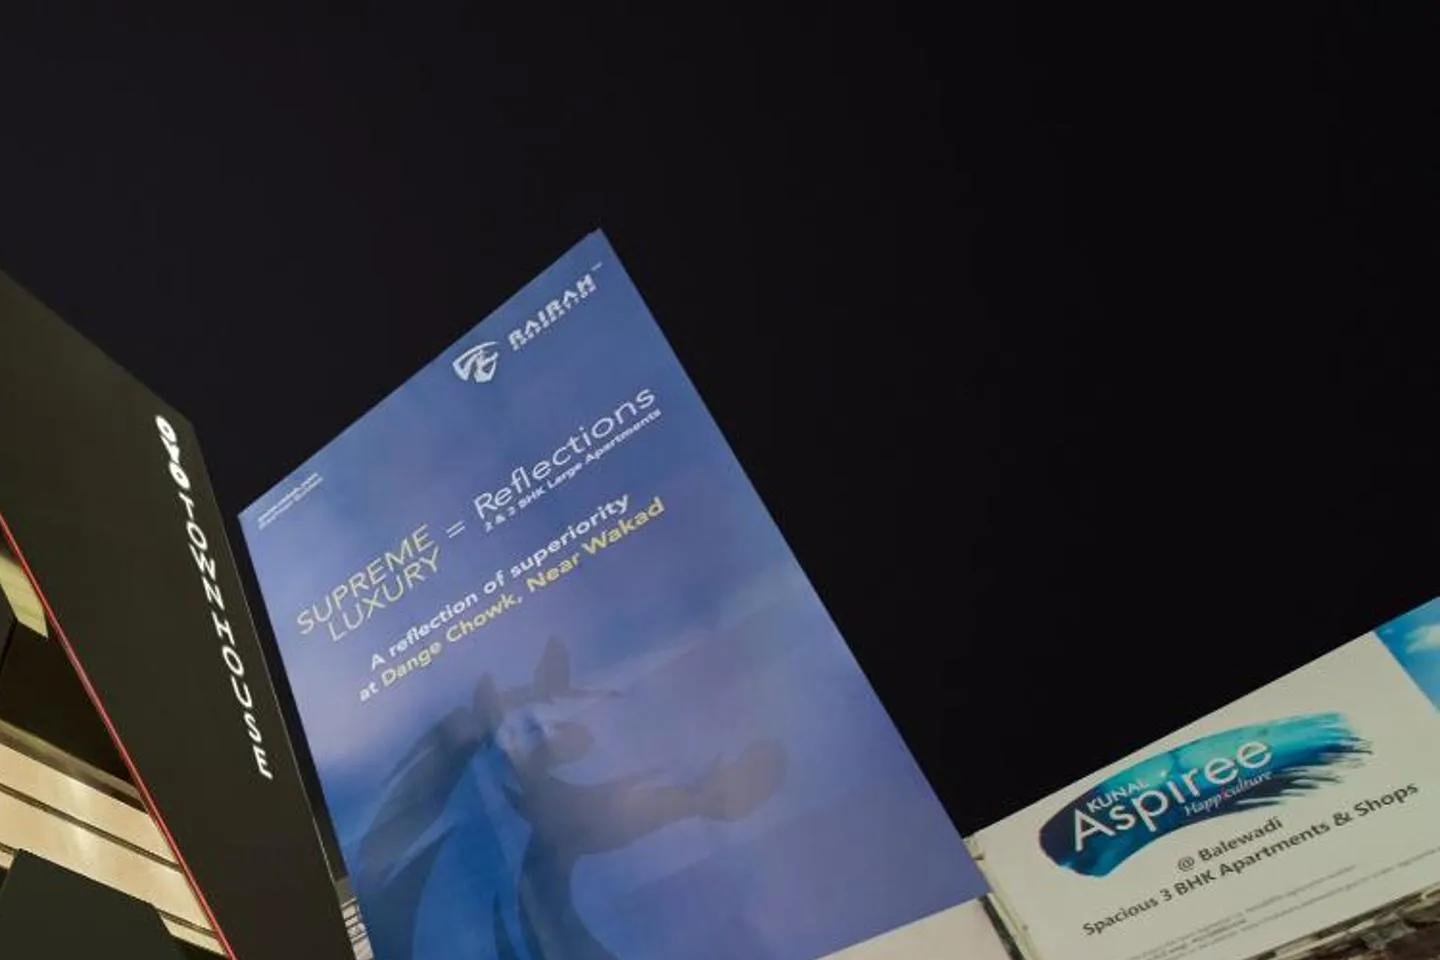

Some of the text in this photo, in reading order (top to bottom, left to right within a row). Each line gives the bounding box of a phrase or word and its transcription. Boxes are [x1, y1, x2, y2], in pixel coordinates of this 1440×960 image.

[474, 388, 655, 520] Reflections
[547, 462, 582, 490] Large
[585, 408, 661, 465] Apartments
[297, 523, 434, 635] SUPREME
[329, 546, 439, 642] LUXURY
[360, 496, 665, 702] at Dange Chowk, Near Wakad
[371, 495, 630, 672] A reflection of superiority
[179, 492, 273, 780] TOWNHOUSE
[1074, 741, 1273, 852] Aspiree
[1086, 778, 1149, 813] KUNAL
[1177, 815, 1284, 873] @ Balewadi
[1082, 782, 1419, 937] Spacious 3 BHK Apartments & Shops
